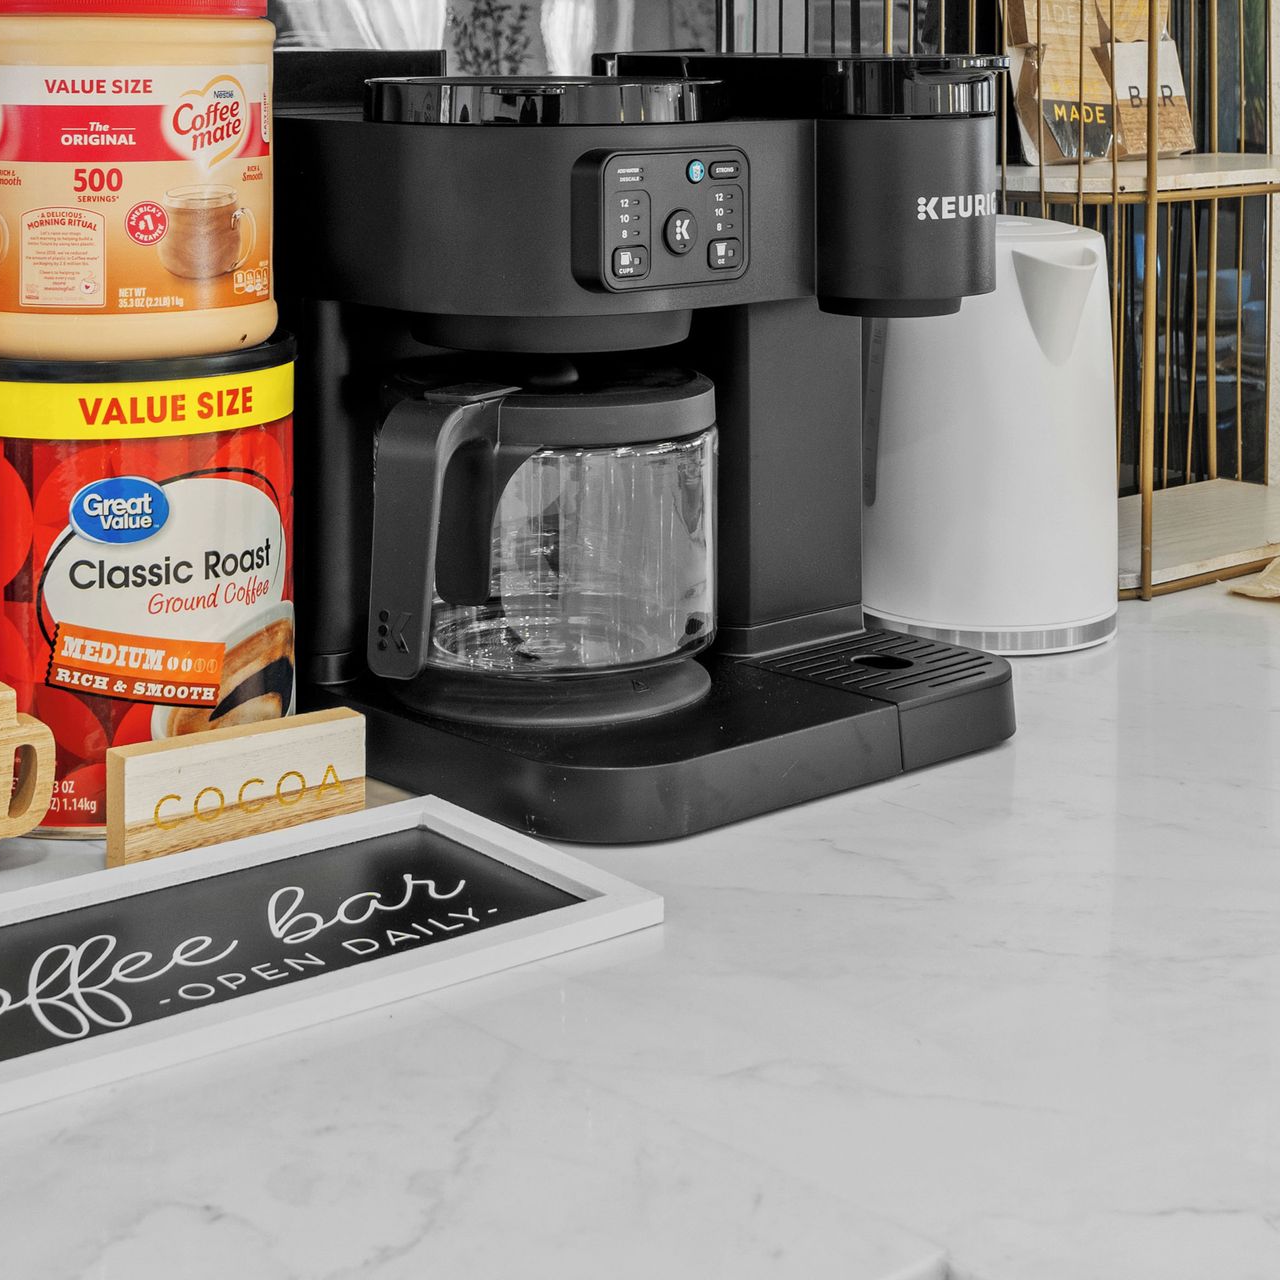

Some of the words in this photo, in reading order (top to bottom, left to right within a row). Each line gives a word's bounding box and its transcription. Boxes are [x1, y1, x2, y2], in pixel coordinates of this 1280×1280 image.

[44, 79, 107, 94] VALUE
[111, 79, 153, 94] SIZE
[1128, 84, 1175, 108] BR
[172, 100, 241, 135] Coffee
[1053, 103, 1107, 124] MADE
[88, 122, 110, 132] The
[192, 118, 242, 151] mate
[60, 134, 137, 146] ORIGINAL
[73, 168, 123, 192] 500
[620, 199, 629, 208] 12
[715, 192, 724, 201] 12
[46, 211, 83, 219] DELICIOUS
[129, 204, 162, 226] AMERICA'S
[620, 214, 630, 223] 10
[714, 208, 724, 217] 10
[27, 219, 66, 231] MORNING
[67, 219, 97, 232] RITUAL
[138, 214, 155, 231] #1
[716, 223, 722, 231] 8
[134, 223, 166, 242] CREAMER
[621, 229, 628, 238] 8
[118, 287, 134, 297] NET
[134, 287, 147, 297] WT
[79, 394, 187, 426] VALUE
[197, 386, 253, 419] SIZE
[82, 492, 153, 517] Great
[99, 514, 154, 531] Value
[70, 555, 194, 591] Classic
[204, 537, 271, 581] Roast
[147, 583, 218, 616] Ground
[223, 574, 270, 607] Coffee
[61, 635, 167, 672] MEDIUM
[55, 668, 110, 691] RICH
[113, 680, 128, 694] &
[132, 681, 217, 701] SMOOTH
[61, 780, 75, 794] OZ
[62, 797, 98, 814] 1.14kg
[153, 764, 347, 832] COCOA
[265, 872, 467, 945] bar
